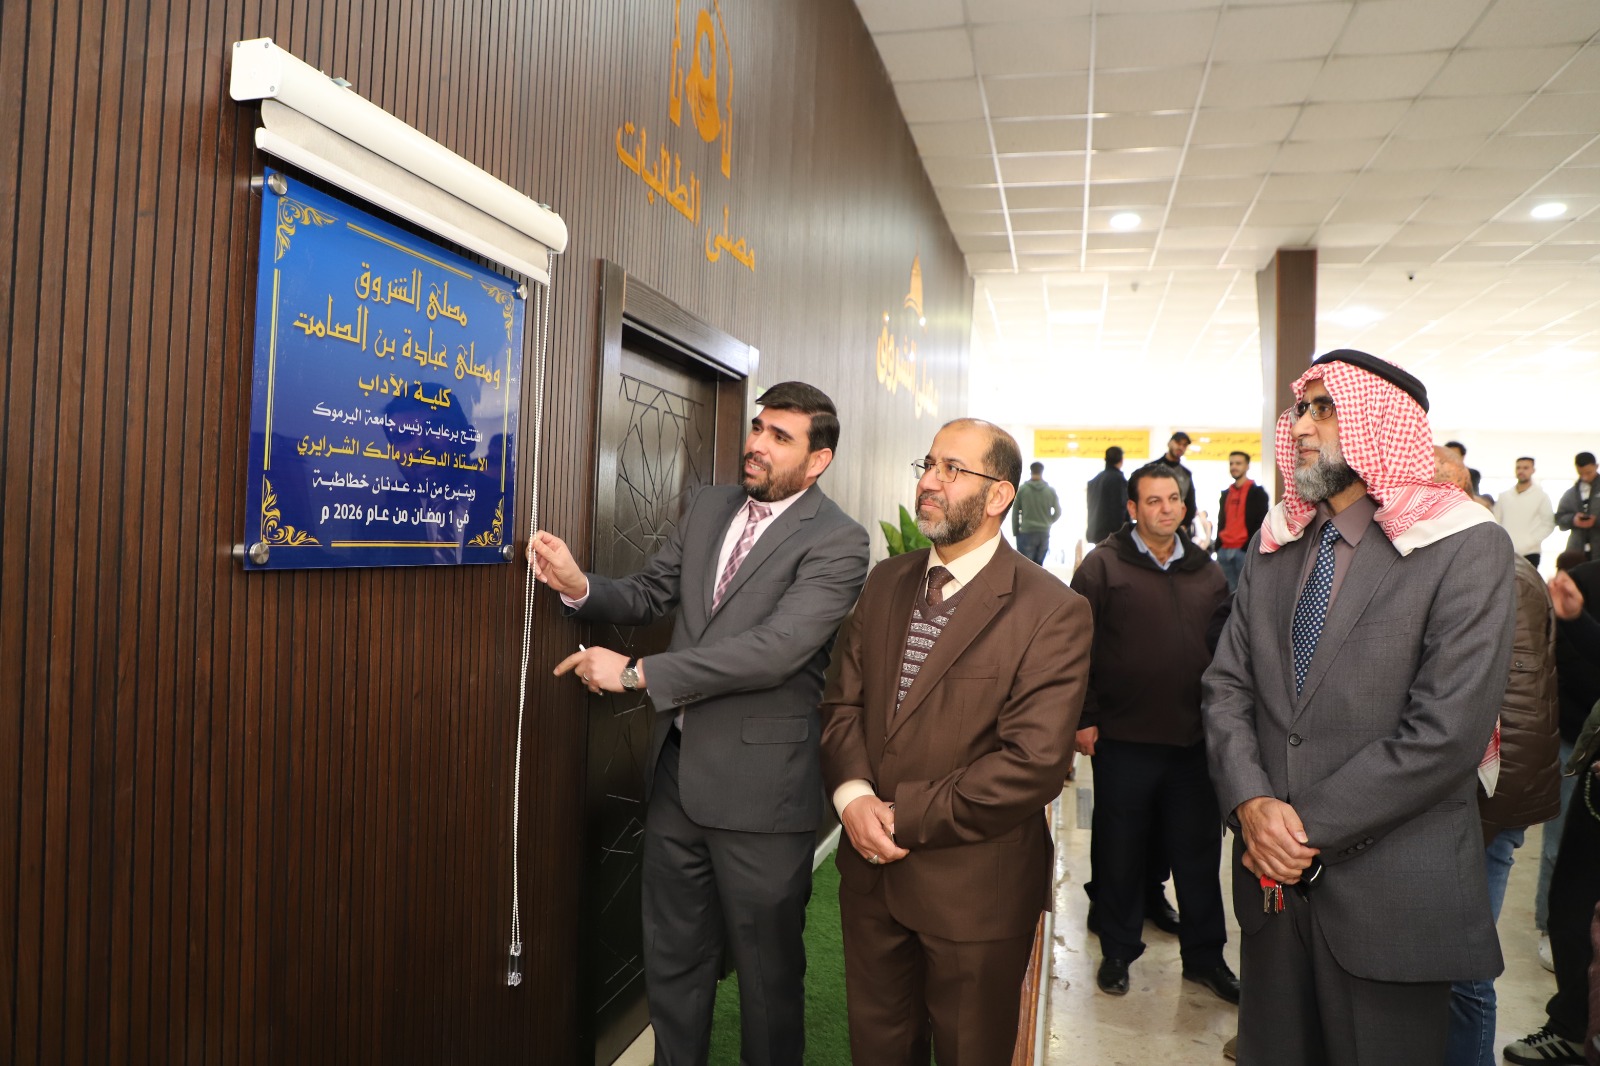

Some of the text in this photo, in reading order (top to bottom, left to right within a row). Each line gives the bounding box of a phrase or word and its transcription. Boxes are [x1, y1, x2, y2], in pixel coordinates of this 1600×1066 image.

[616, 121, 755, 272] مصلى الطالبات
[354, 261, 467, 327] مصلى الشروق
[293, 293, 500, 390] ومصلى عبادة بن الصامت
[358, 373, 452, 411] كلية الآداب
[312, 402, 483, 445] افتتح برعاية رئيس جامعة اليرموك
[297, 435, 360, 458] الشرايري
[362, 441, 401, 461] مالك
[400, 447, 450, 467] الدكتور
[312, 469, 369, 491] خطاطبة
[372, 476, 410, 494] عدنان
[430, 481, 443, 498] من
[444, 483, 476, 501] ويتبرع
[320, 503, 470, 532] في 1 رمضان من عام 2026 م
